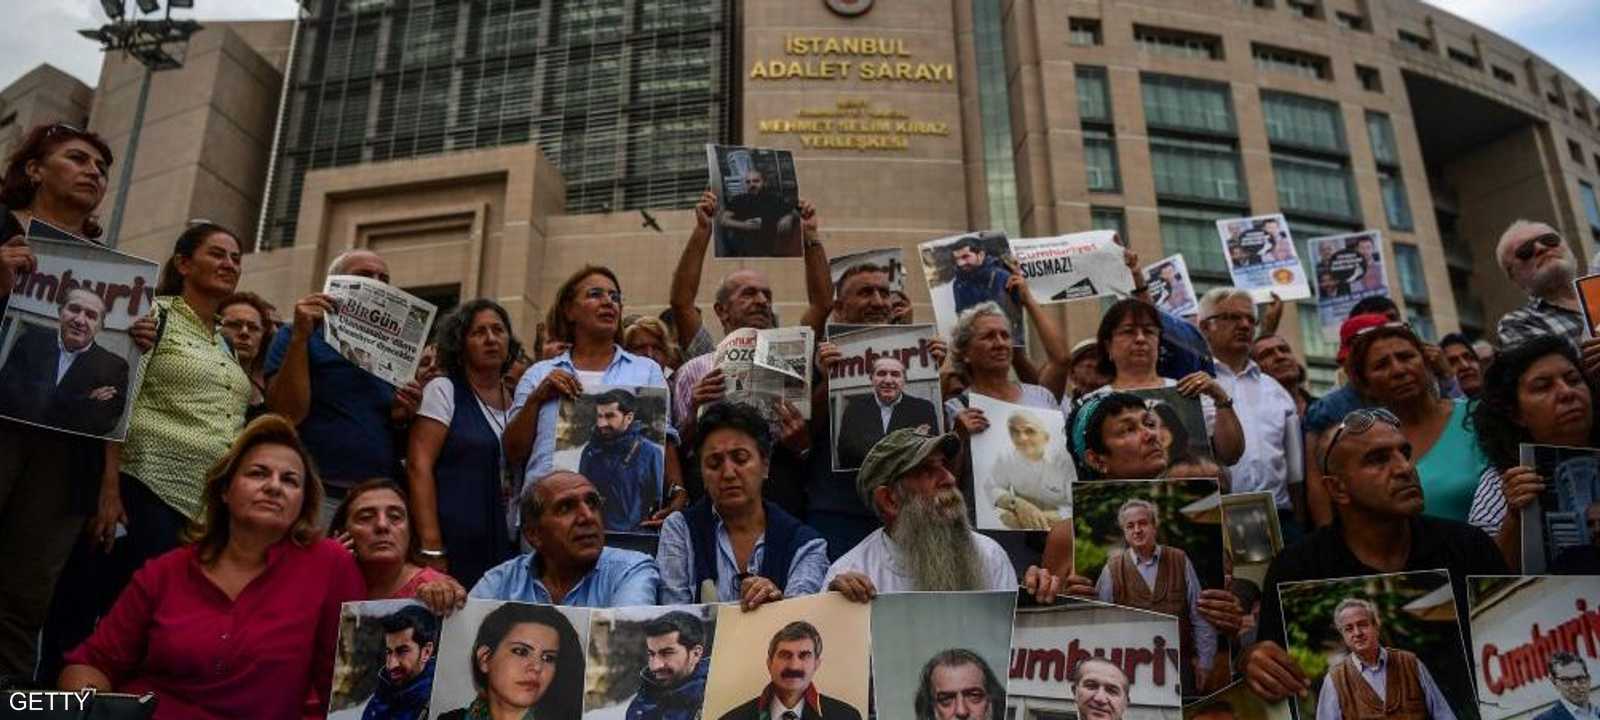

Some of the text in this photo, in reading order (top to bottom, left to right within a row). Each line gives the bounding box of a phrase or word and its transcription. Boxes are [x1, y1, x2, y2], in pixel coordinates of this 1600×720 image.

[786, 34, 911, 56] İSTANBUL
[751, 61, 954, 80] ADALET SARAYI
[1020, 256, 1073, 278] SUSMAZ!
